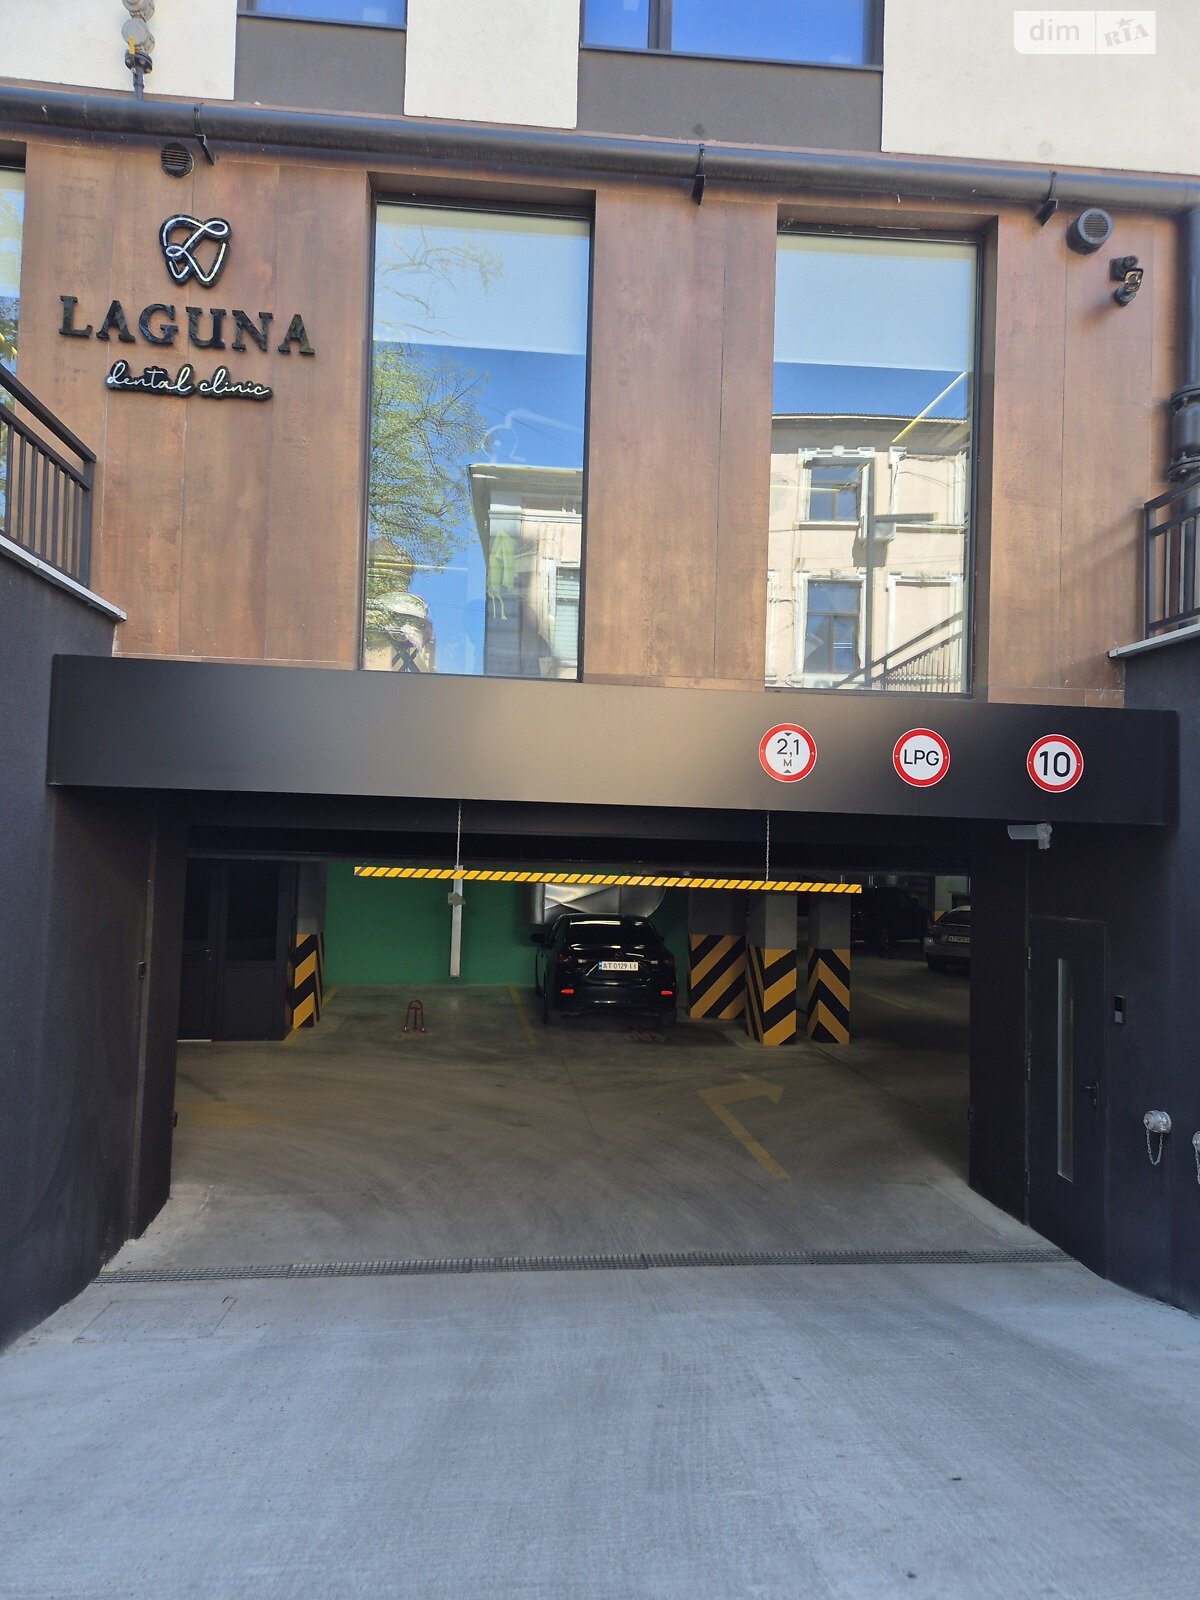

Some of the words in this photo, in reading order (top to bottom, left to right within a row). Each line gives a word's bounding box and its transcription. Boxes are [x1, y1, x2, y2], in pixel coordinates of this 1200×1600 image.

[59, 295, 314, 355] LAGUNA
[106, 361, 192, 394] dental
[199, 365, 270, 396] clinic
[776, 738, 800, 757] 2,1
[903, 749, 940, 766] LPG
[1039, 751, 1071, 777] 10
